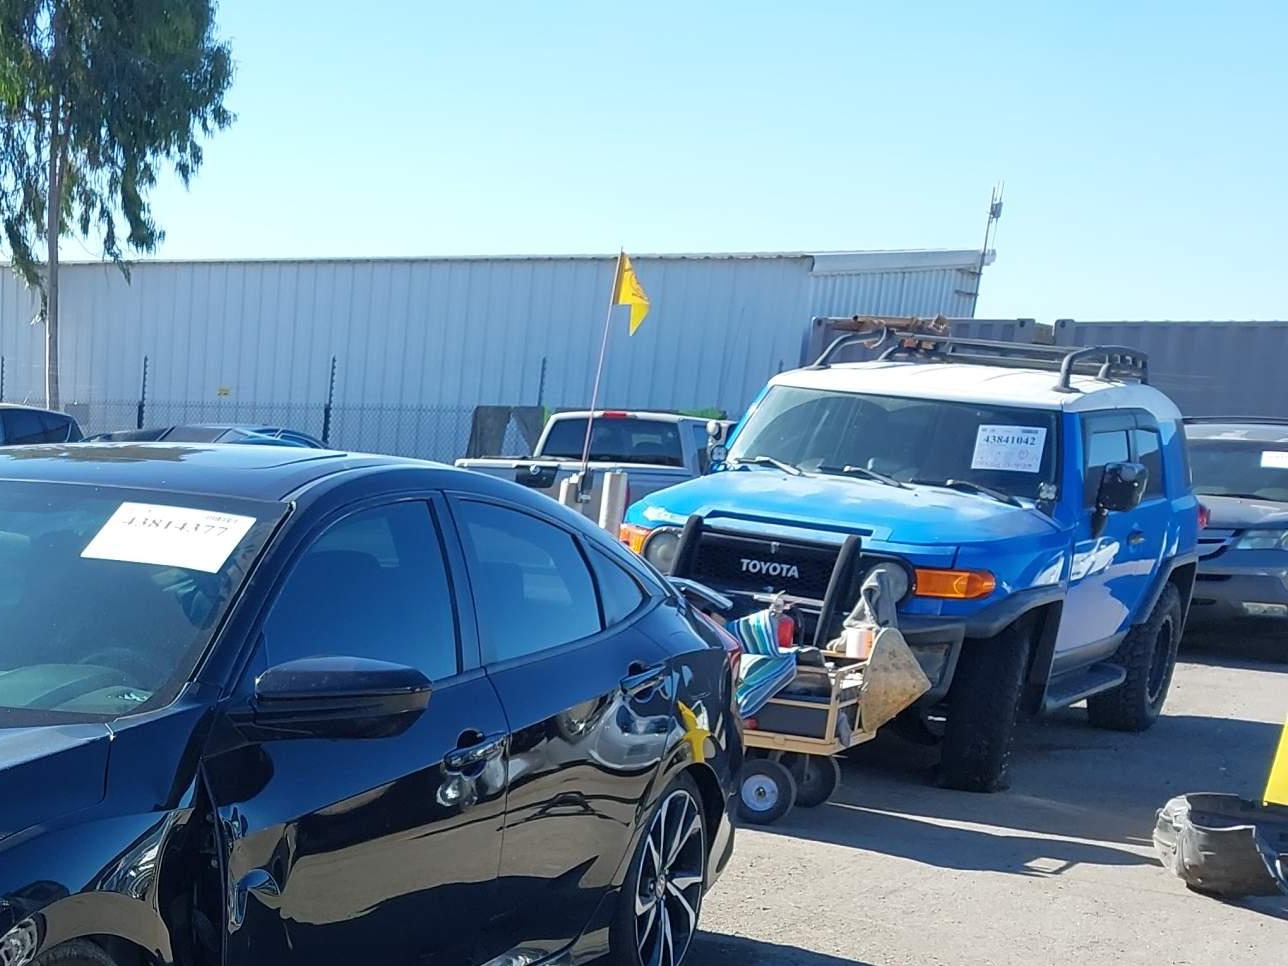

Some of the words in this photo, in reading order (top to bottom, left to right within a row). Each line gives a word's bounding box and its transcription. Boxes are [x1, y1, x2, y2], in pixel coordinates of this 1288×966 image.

[983, 434, 1037, 446] 43841042
[122, 516, 229, 537] 43814377
[740, 558, 799, 579] TOYOTA
